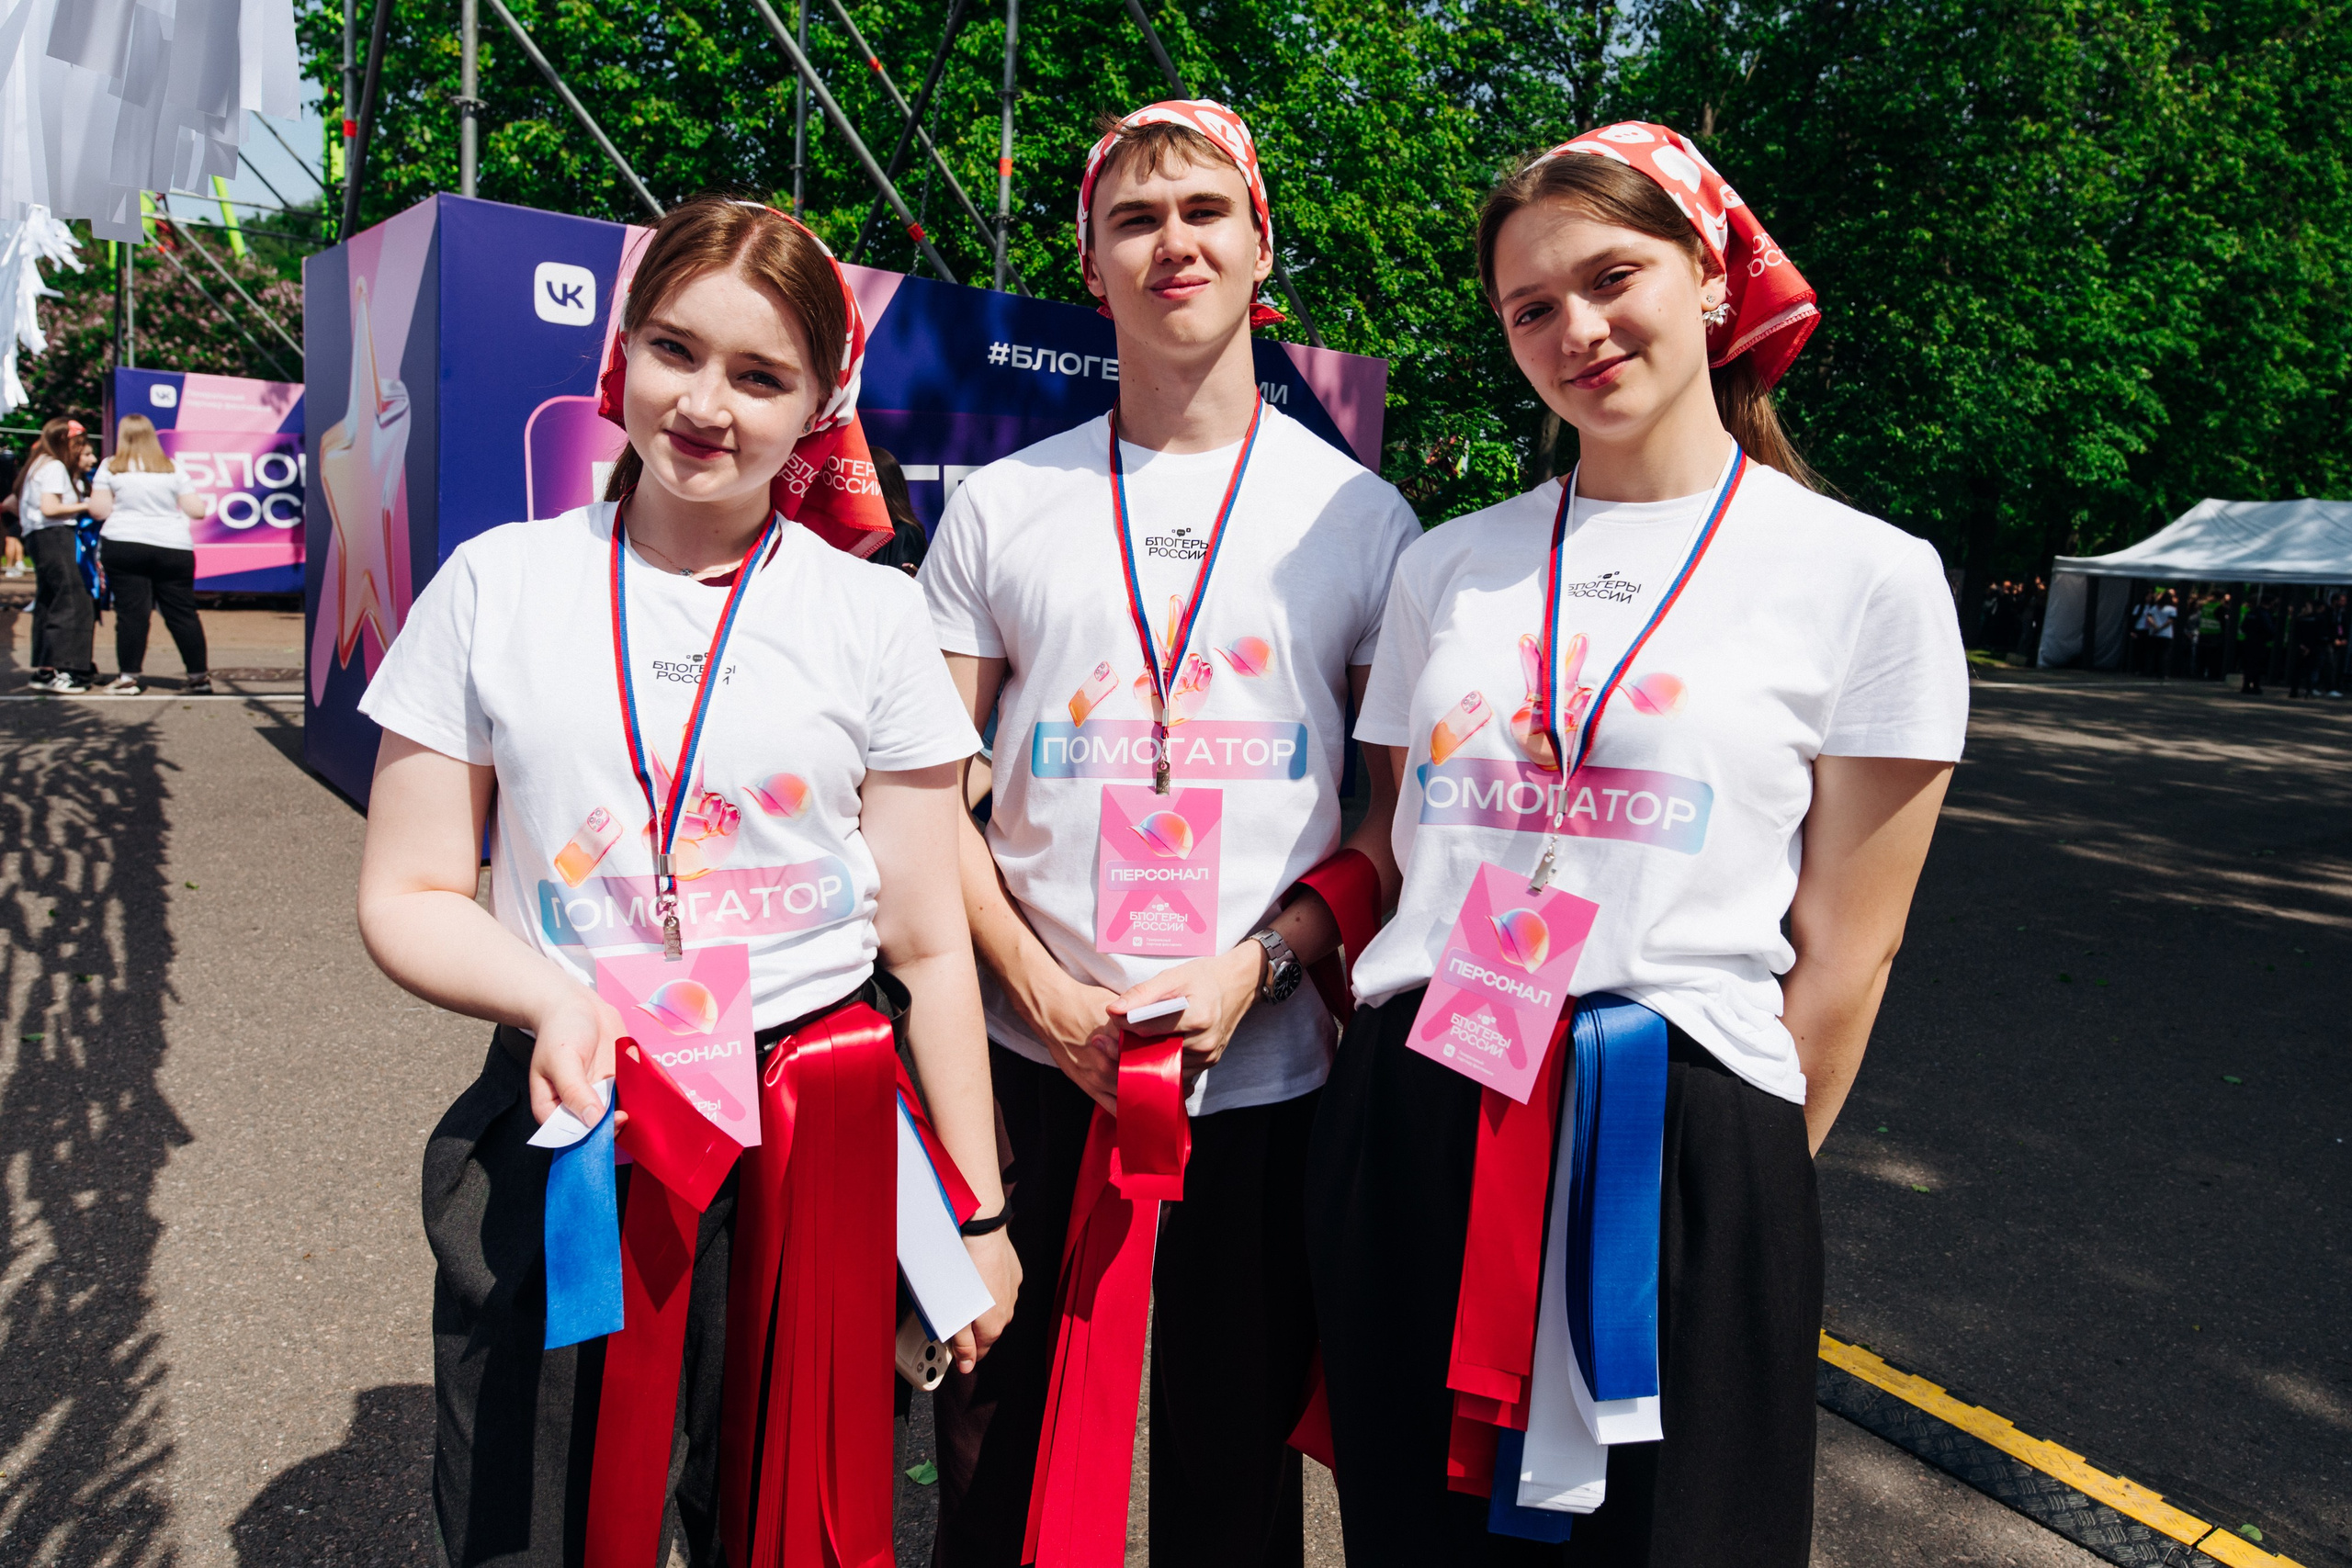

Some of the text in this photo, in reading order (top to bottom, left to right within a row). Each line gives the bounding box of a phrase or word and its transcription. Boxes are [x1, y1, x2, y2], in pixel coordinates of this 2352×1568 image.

[546, 280, 584, 309] VK
[1043, 736, 1296, 766] ПОМОГАТОР
[1111, 868, 1209, 882] ПЕРСОНАЛ
[1129, 911, 1188, 922] БЛОГЕРЫ
[1133, 921, 1184, 931] РОССИИ
[1448, 957, 1553, 1008] ПЕРСОНАЛ
[1449, 1025, 1506, 1058] РОССИИ
[1450, 1012, 1511, 1049] БЛОГЕРЫ
